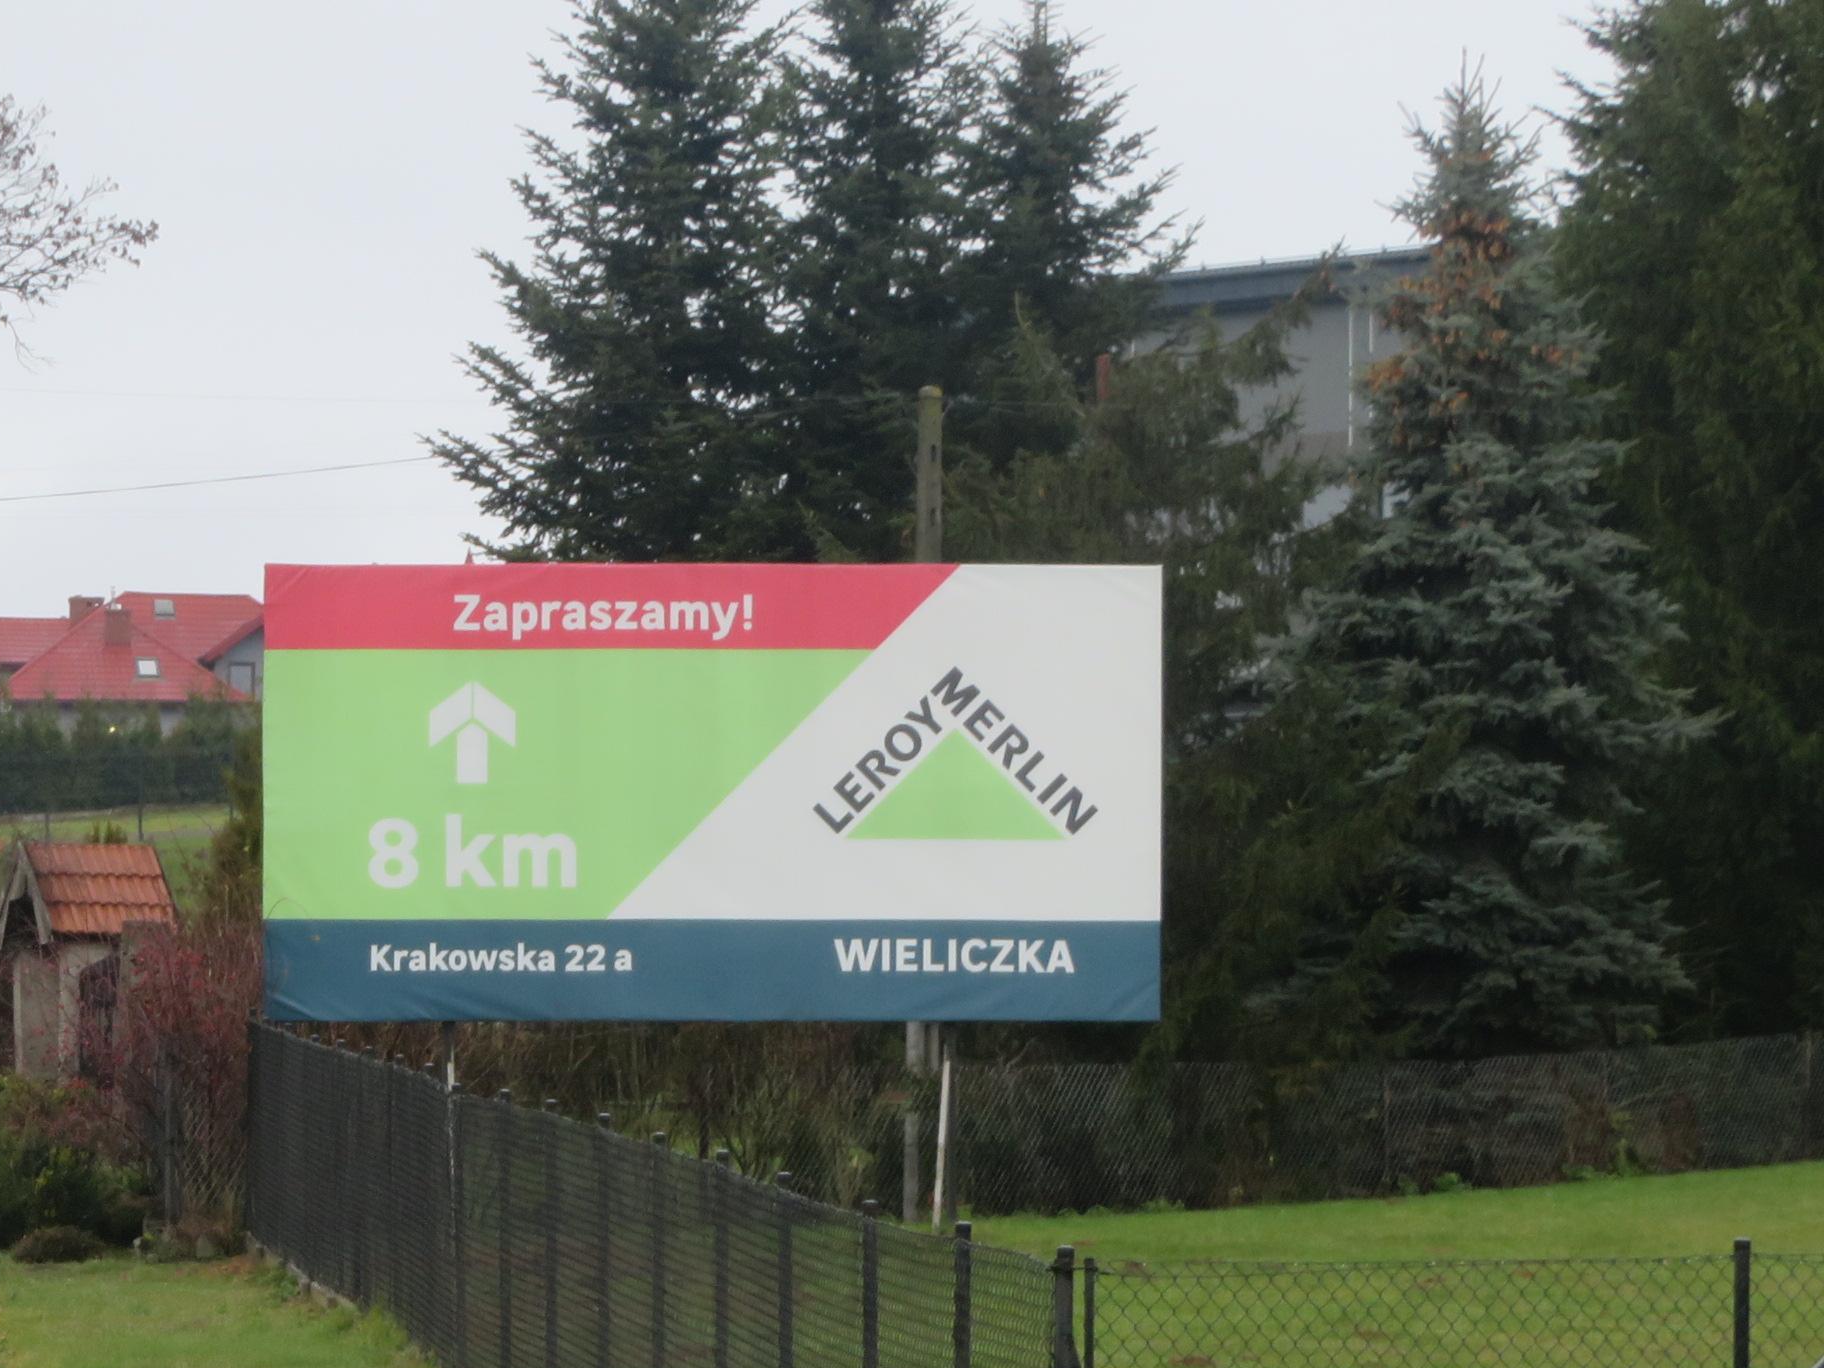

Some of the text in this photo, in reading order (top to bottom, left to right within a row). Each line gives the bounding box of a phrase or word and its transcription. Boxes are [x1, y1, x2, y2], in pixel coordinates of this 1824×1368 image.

[453, 594, 753, 640] Zapraszamy!
[812, 665, 1098, 835] LEROY MERLIN
[367, 813, 577, 889] 8 km
[370, 942, 633, 973] Krakowska 22 a
[833, 938, 1075, 975] WIELICZKA
